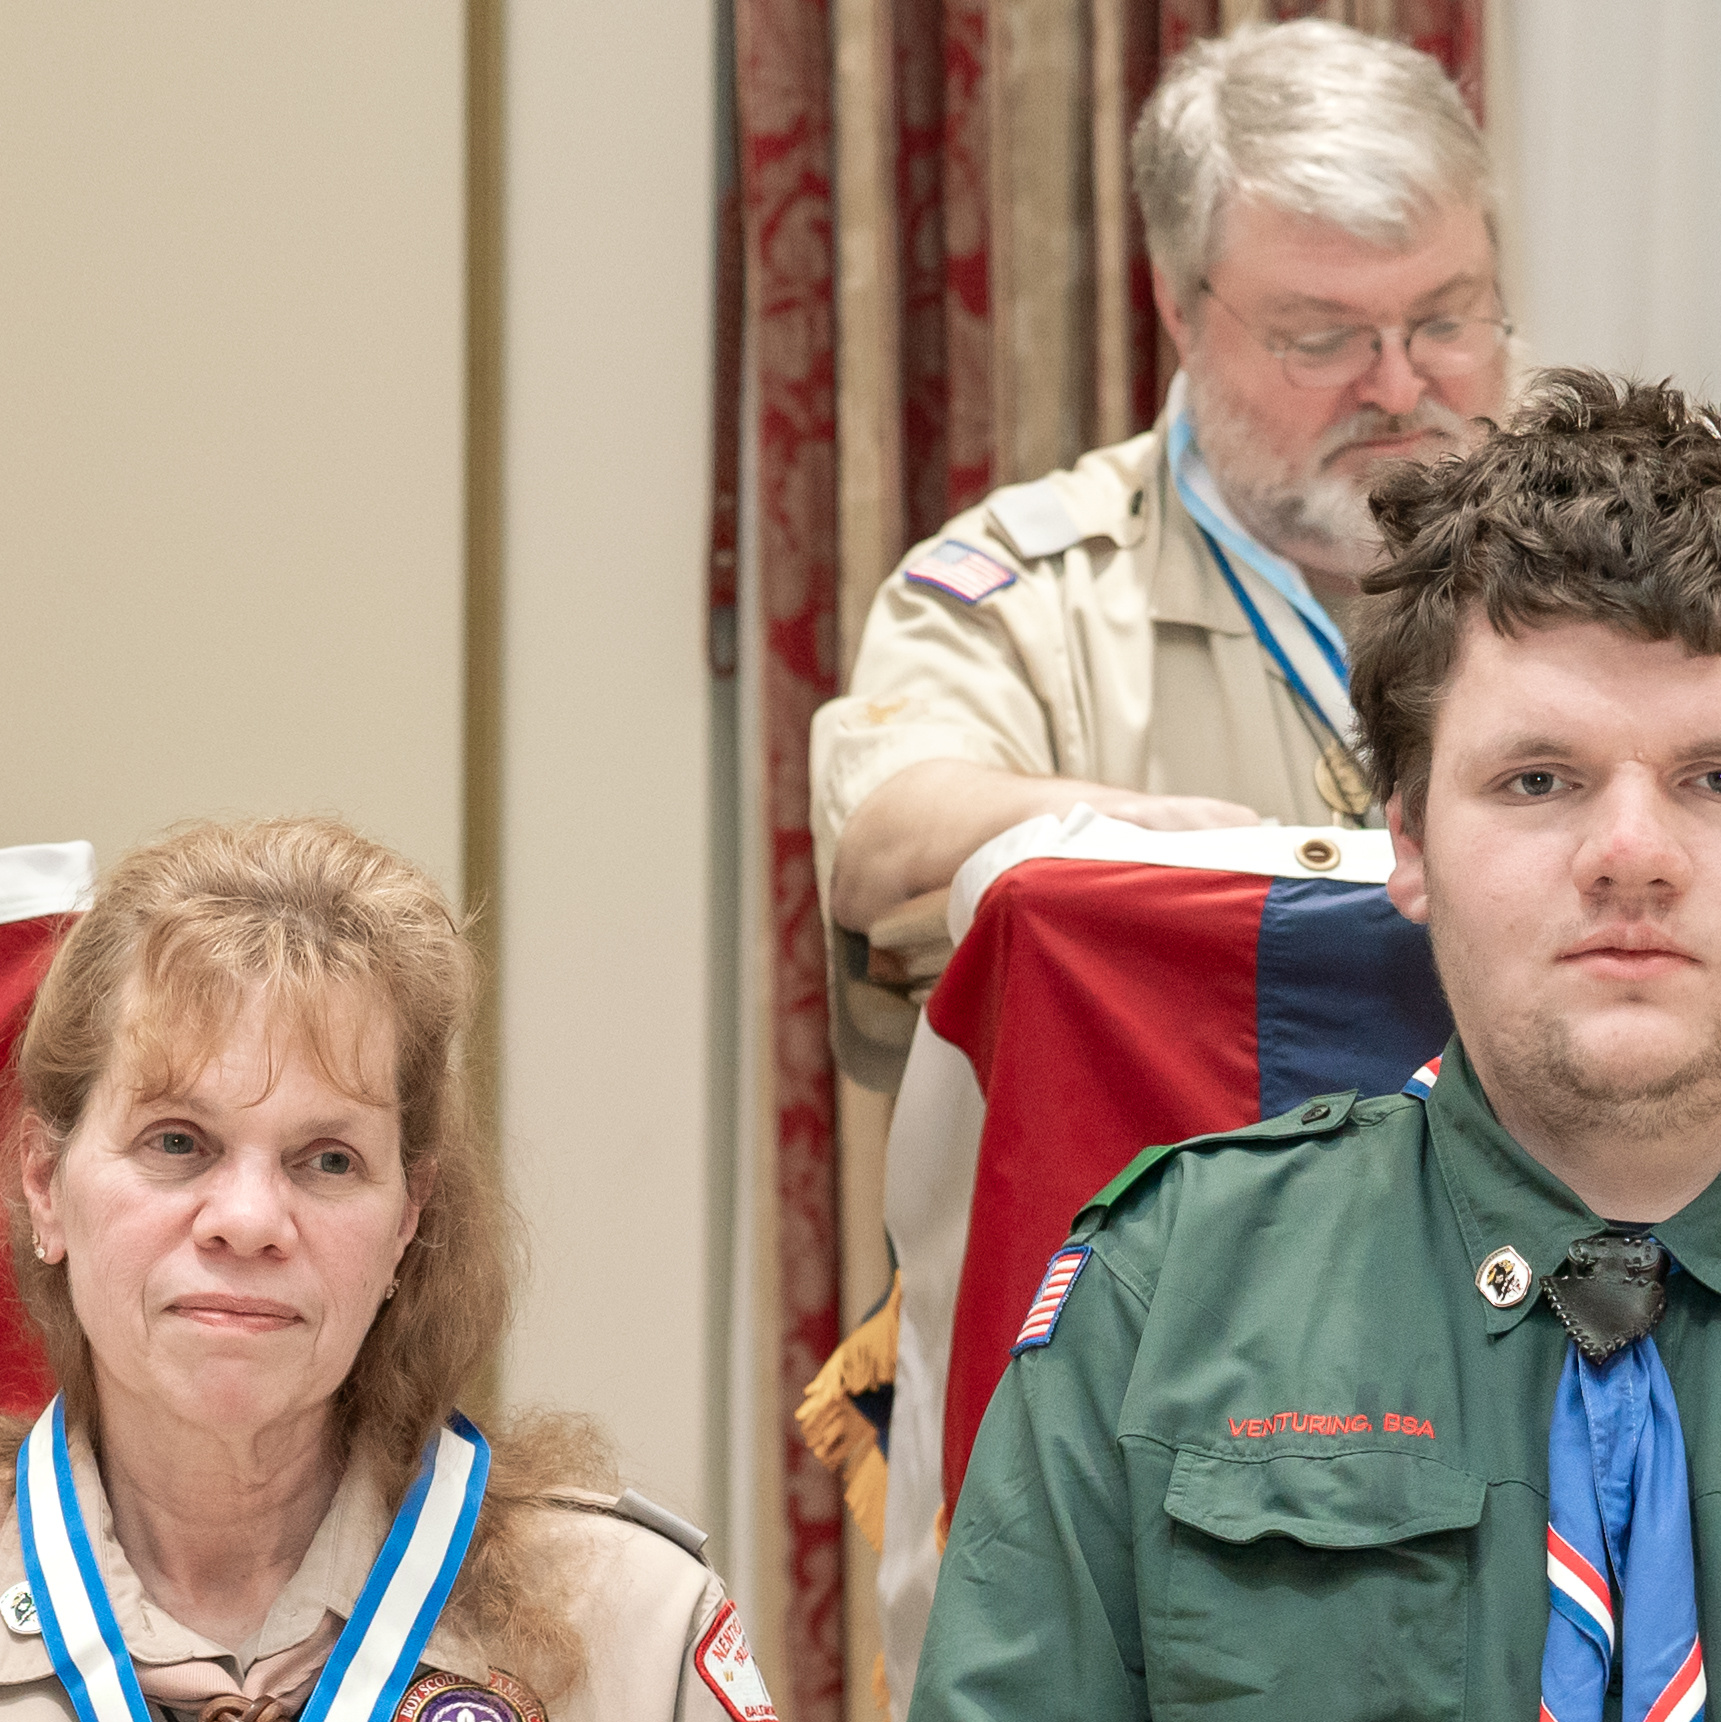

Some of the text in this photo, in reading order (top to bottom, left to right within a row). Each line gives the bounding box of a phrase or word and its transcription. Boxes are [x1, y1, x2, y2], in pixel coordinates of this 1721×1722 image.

[1383, 1412, 1436, 1439] BSA
[712, 1616, 743, 1663] NENTIC
[400, 1691, 421, 1719] BOY
